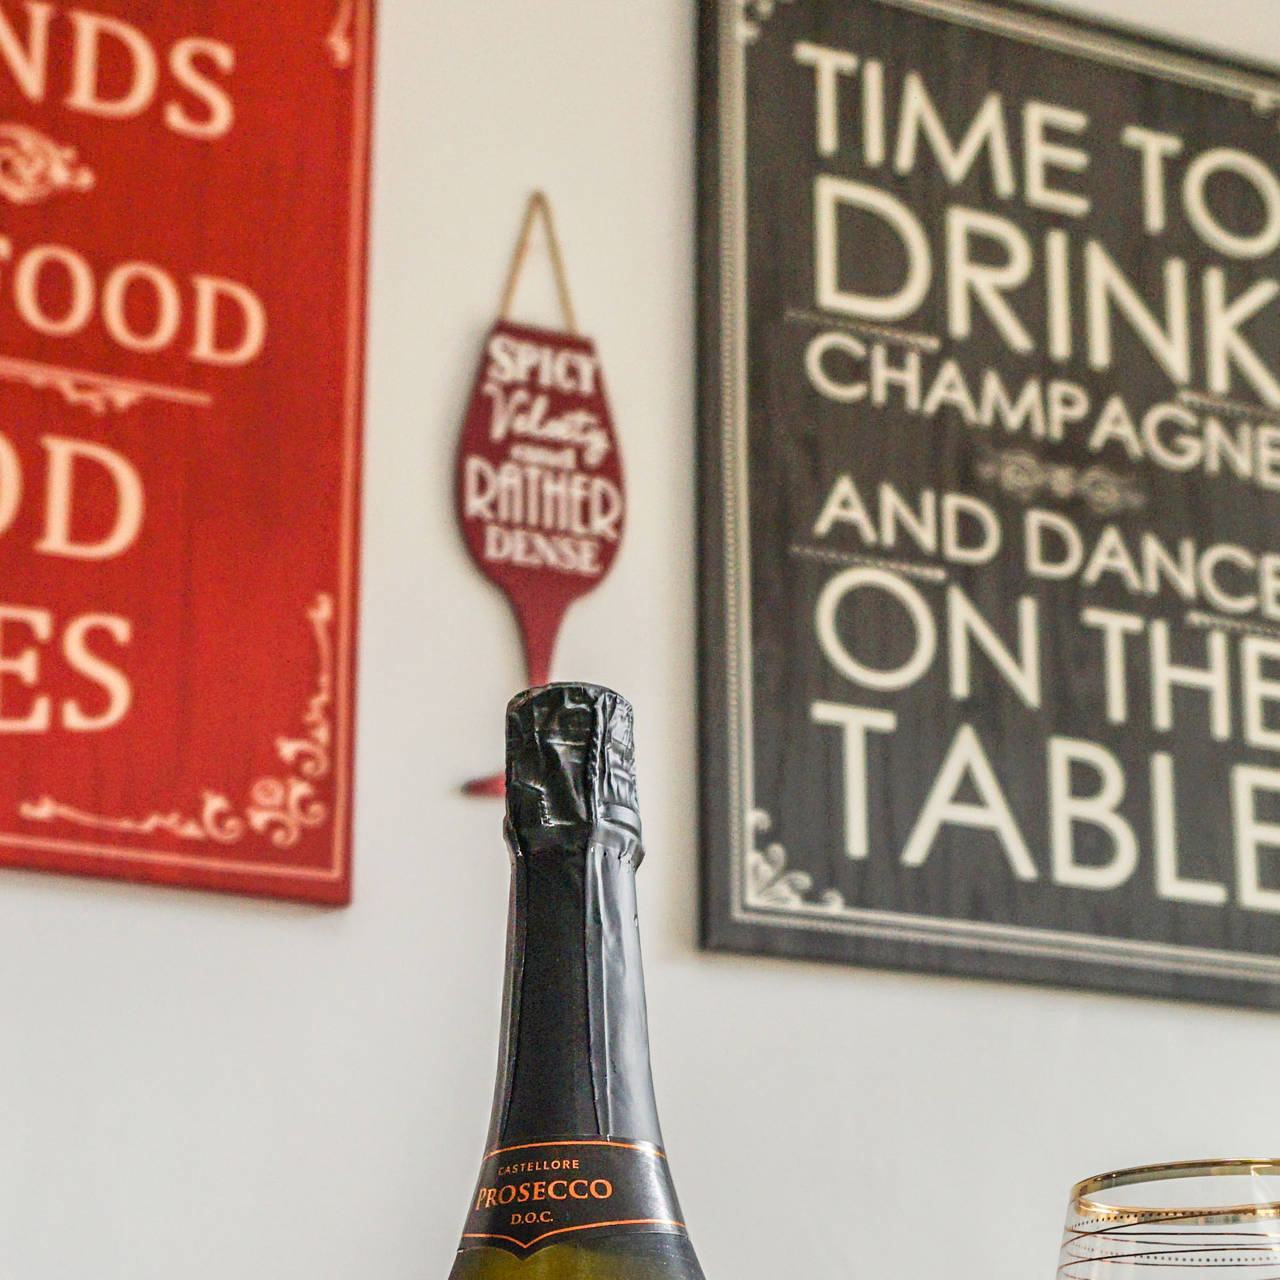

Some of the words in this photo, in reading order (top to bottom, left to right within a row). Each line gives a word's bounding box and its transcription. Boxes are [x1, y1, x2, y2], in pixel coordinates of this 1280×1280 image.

[793, 41, 1090, 216] TIME
[463, 453, 623, 541] RATHER
[814, 475, 1002, 565] AND
[484, 523, 602, 578] DENSE
[815, 565, 1042, 709] ON
[475, 1179, 613, 1211] PROSECCO
[497, 1159, 580, 1176] CASTELLORE
[509, 1210, 554, 1225] D.O.C.
